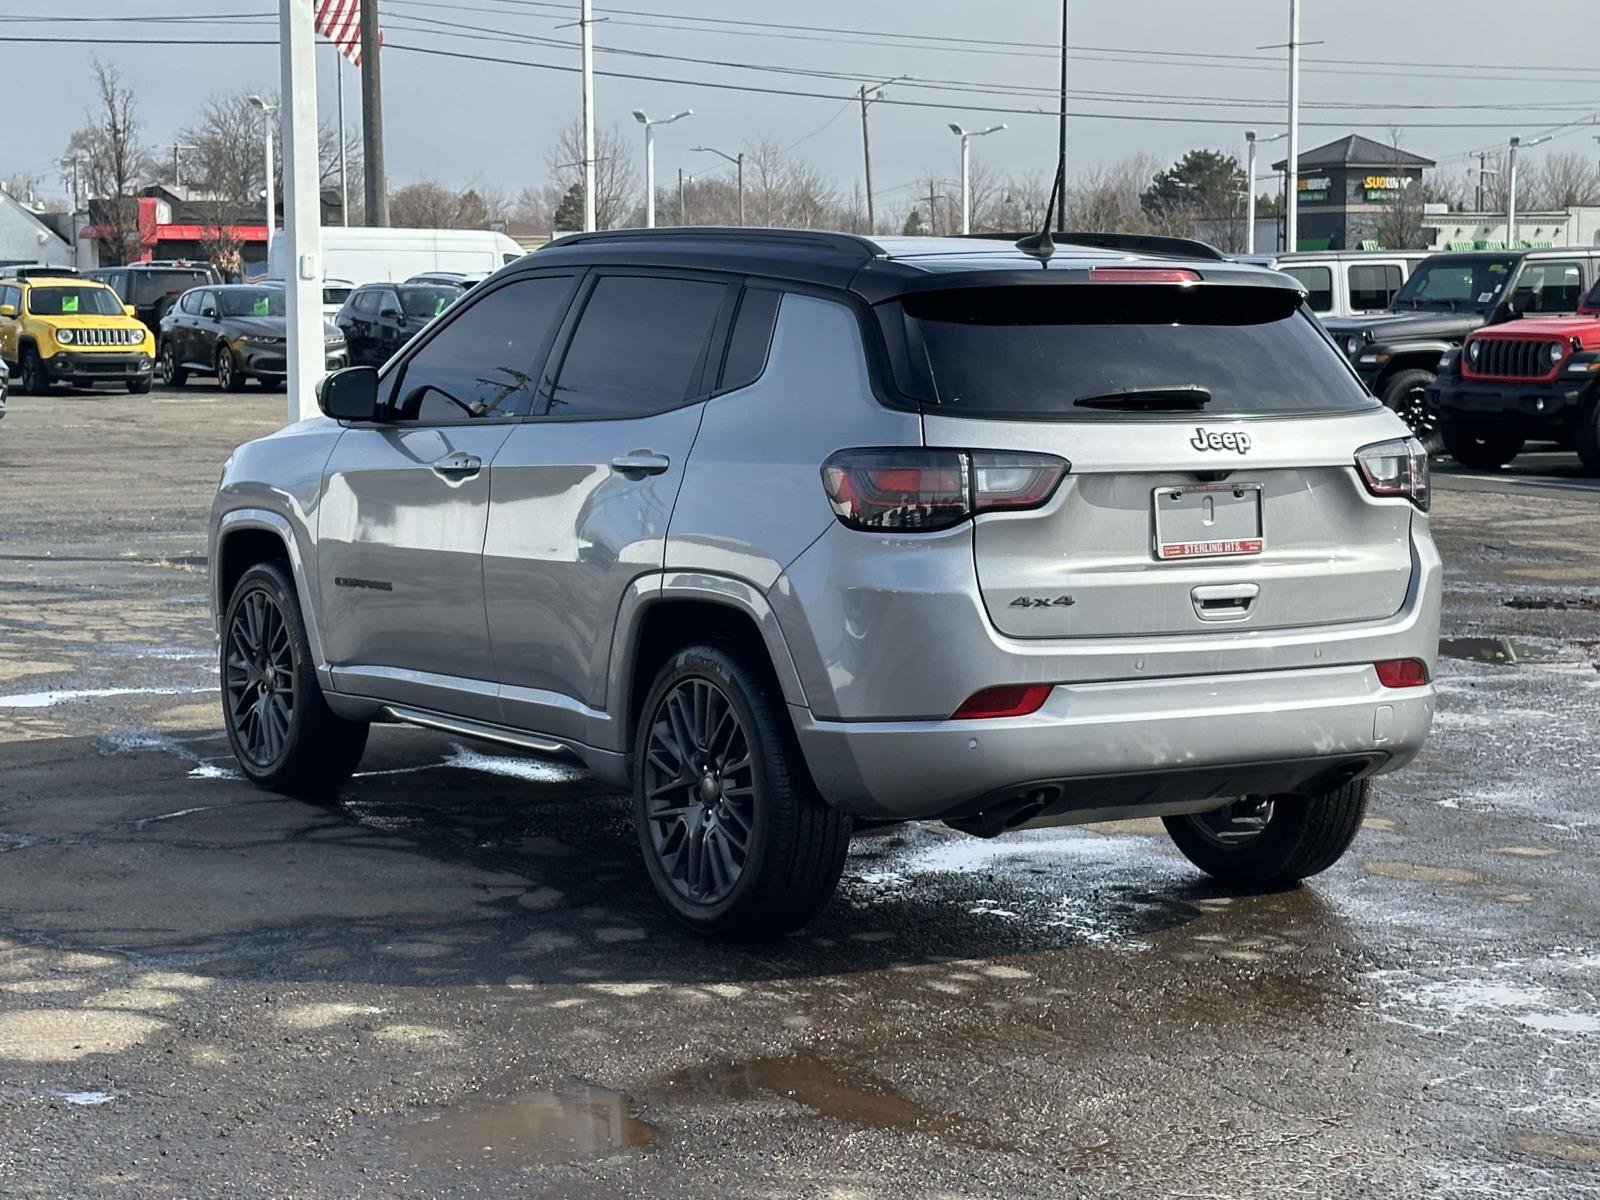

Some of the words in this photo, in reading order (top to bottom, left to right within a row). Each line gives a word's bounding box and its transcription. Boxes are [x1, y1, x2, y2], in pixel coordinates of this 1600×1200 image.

[1190, 427, 1251, 455] Jeep
[1184, 542, 1223, 554] STERLING
[1010, 595, 1076, 607] 4x4
